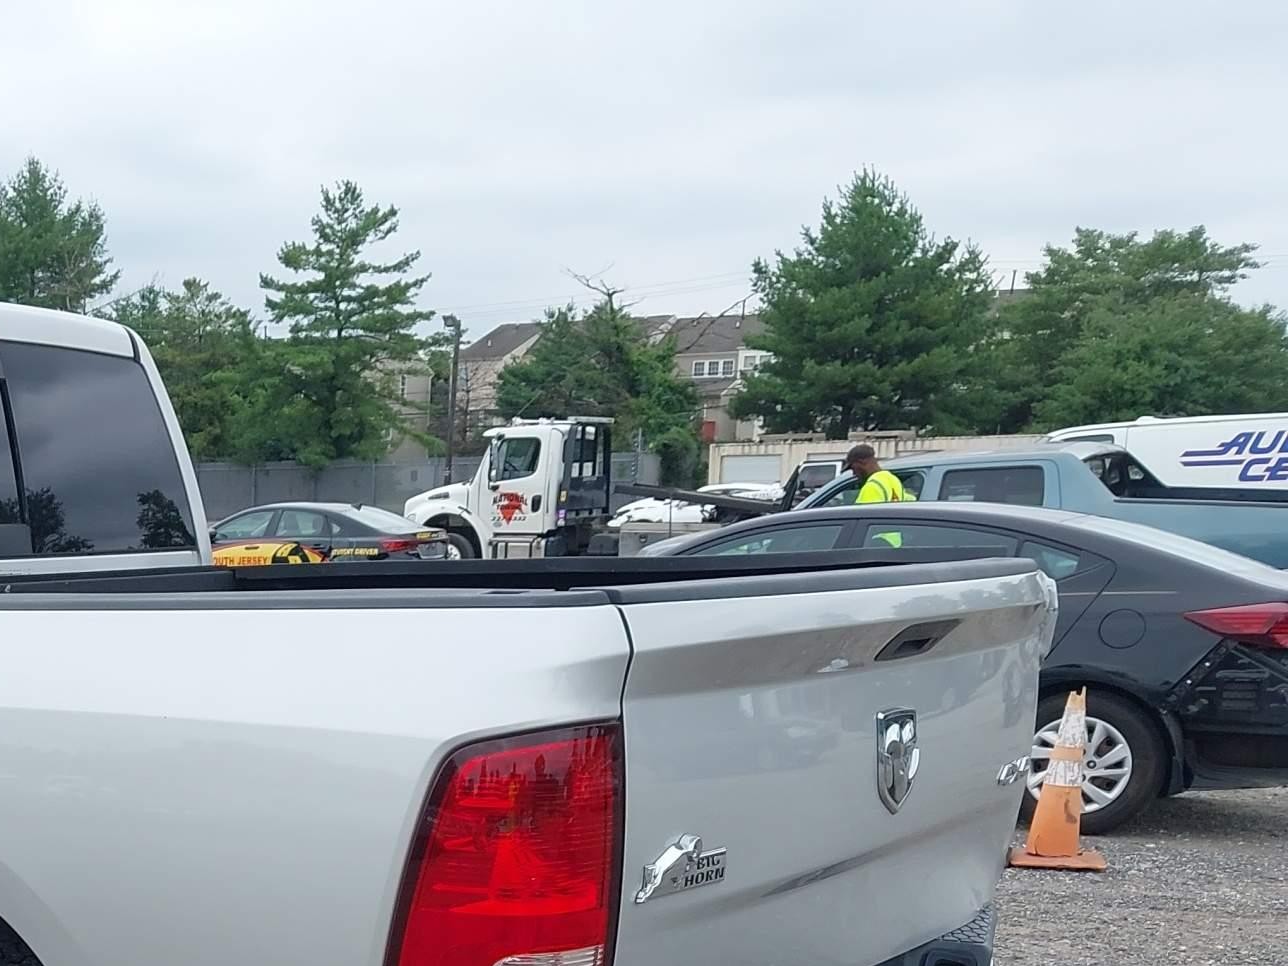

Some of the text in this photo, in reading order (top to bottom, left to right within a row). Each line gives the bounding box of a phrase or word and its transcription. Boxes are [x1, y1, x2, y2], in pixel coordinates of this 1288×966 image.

[1217, 430, 1288, 455] AU
[696, 854, 721, 870] BIG
[684, 867, 725, 888] HORN
